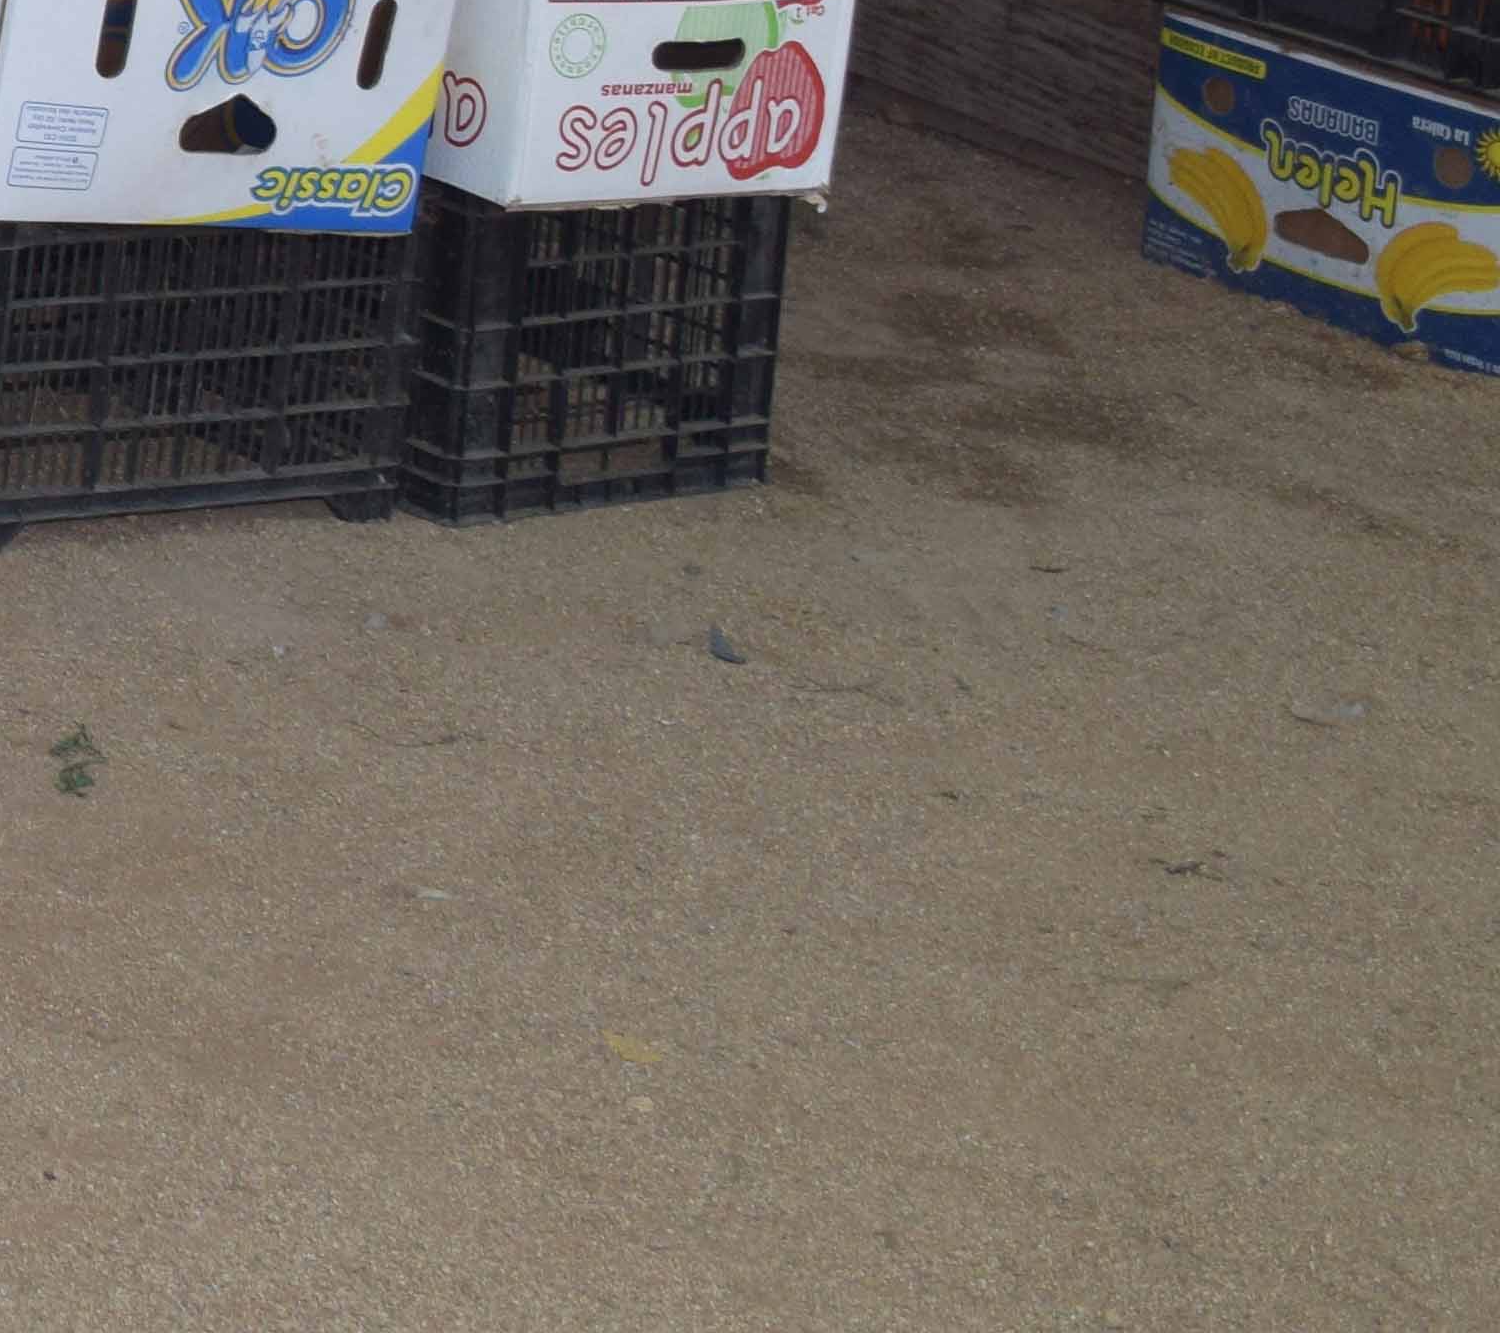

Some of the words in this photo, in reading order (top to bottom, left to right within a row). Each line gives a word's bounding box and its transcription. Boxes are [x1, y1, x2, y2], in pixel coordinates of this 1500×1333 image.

[601, 83, 692, 97] manzanas
[556, 76, 802, 186] apples
[1288, 95, 1379, 146] BANANAS
[1454, 126, 1470, 146] La
[252, 166, 413, 213] Classic
[1261, 119, 1401, 228] Helen
